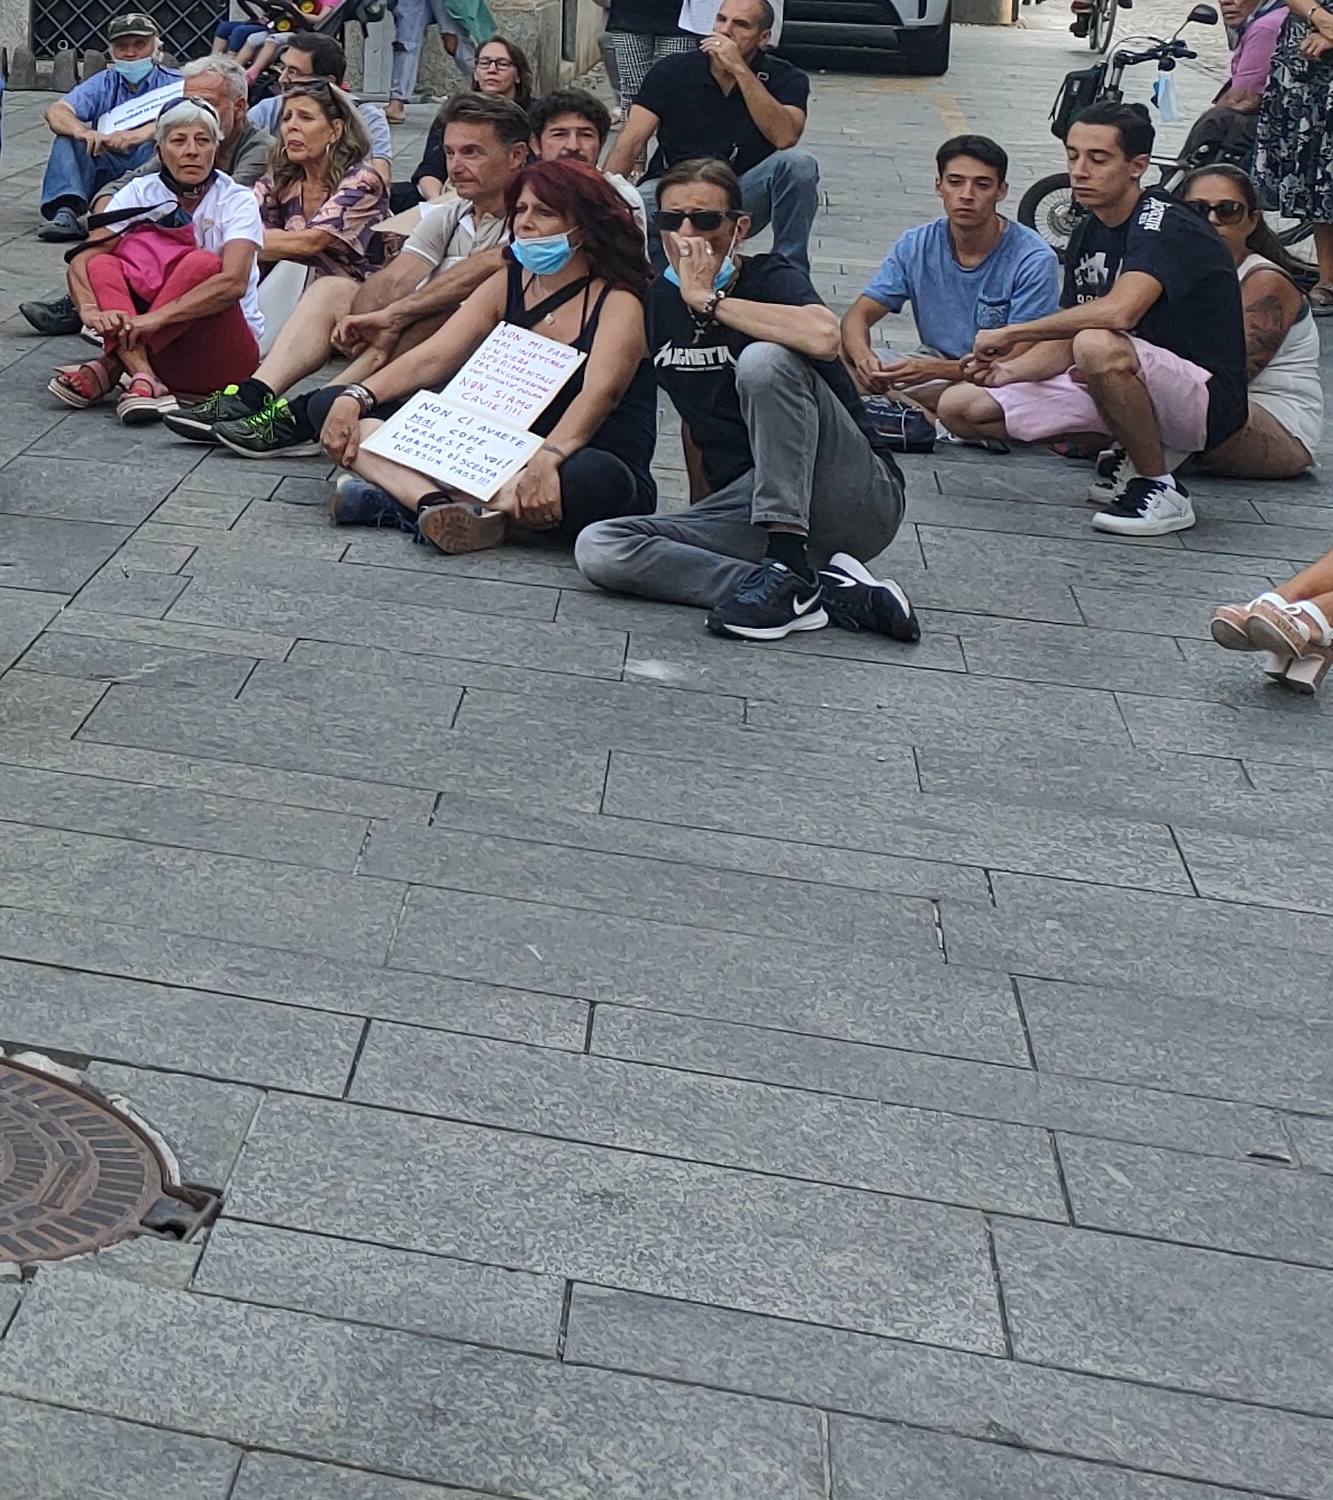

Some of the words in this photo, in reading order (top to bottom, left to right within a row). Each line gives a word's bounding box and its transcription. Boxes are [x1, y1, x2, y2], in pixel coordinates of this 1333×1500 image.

[498, 328, 524, 342] NON
[458, 377, 488, 392] NON
[493, 389, 533, 410] SIAMO
[461, 392, 501, 411] CAVIE
[418, 402, 453, 418] NON
[457, 416, 475, 426] CI
[477, 425, 527, 449] AVRETE
[404, 423, 475, 455] VORRESTE
[449, 428, 488, 447] COME
[393, 443, 444, 466] NESSUN
